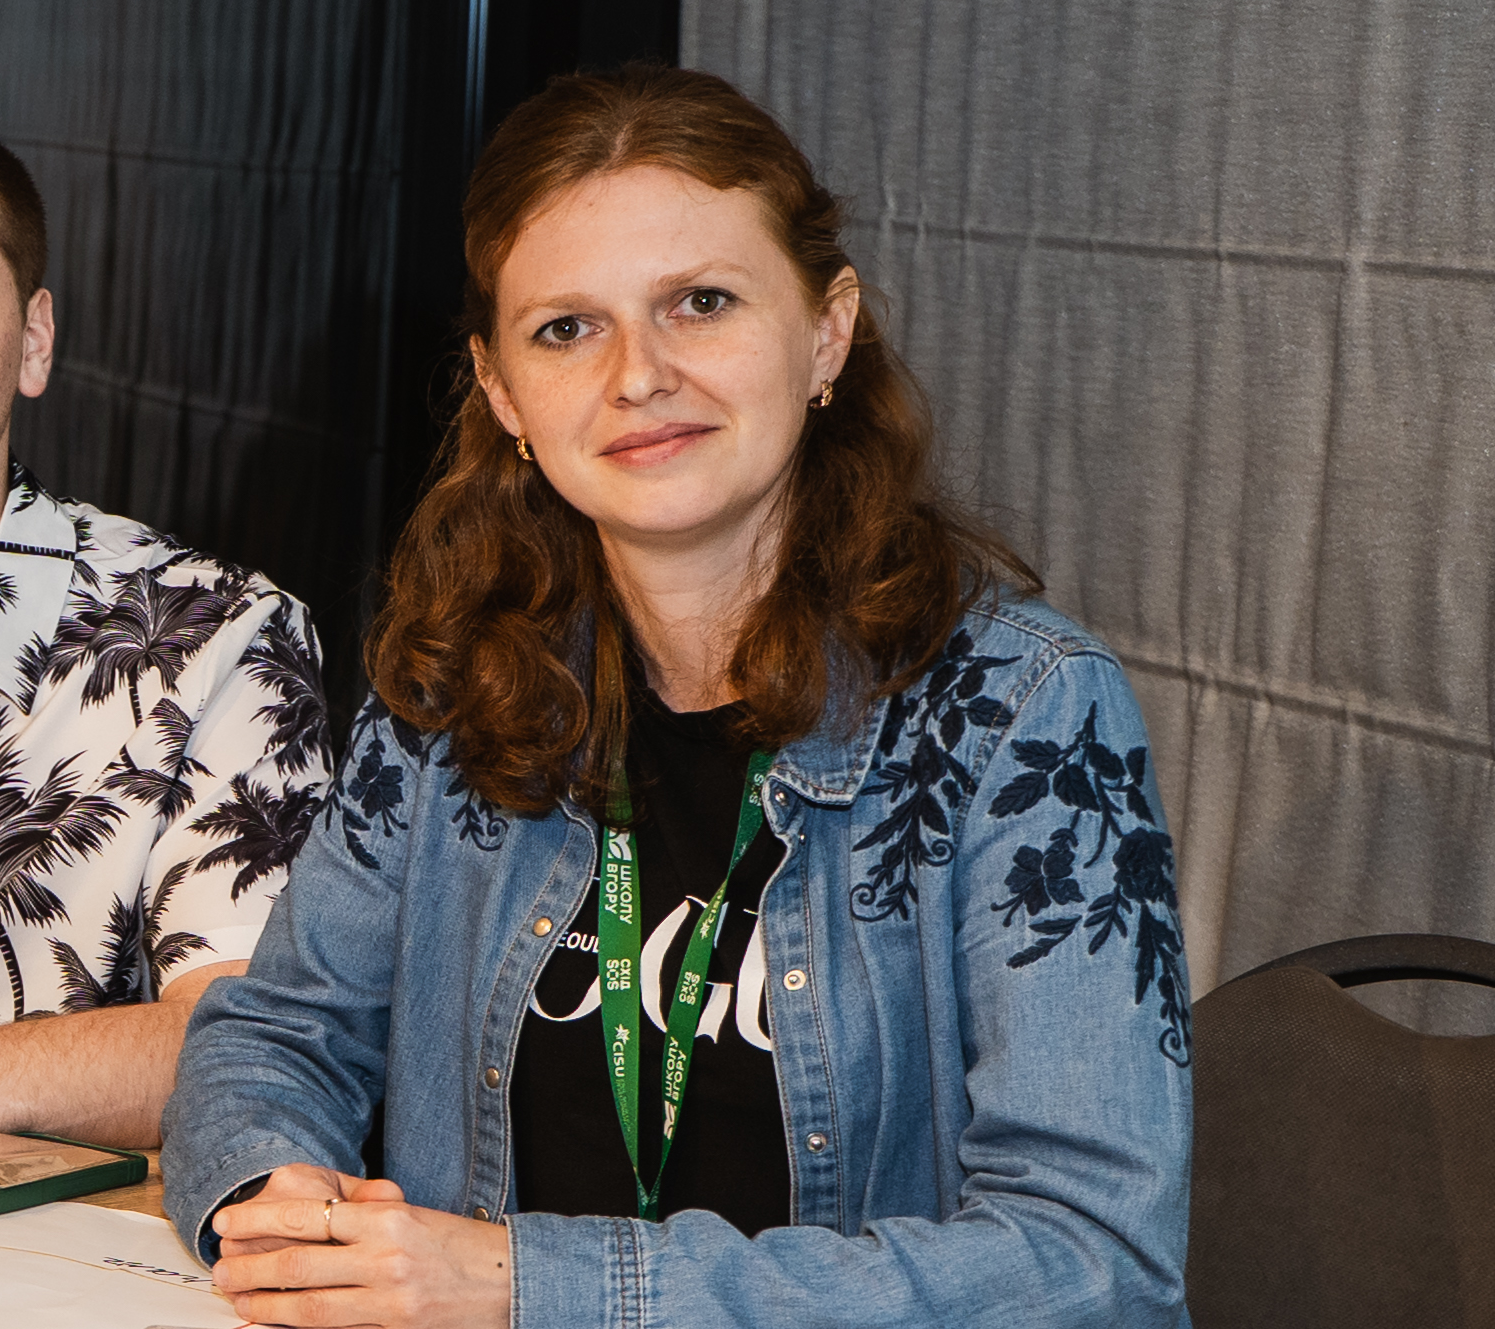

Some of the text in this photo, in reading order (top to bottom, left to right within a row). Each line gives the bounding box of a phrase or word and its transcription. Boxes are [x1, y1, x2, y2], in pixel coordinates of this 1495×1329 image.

[605, 863, 618, 915] ВГОРУ
[620, 865, 632, 924] ШКОЛУ
[606, 959, 619, 991] SOS
[620, 958, 631, 991] СХІД
[679, 971, 692, 1002] СХІД
[686, 973, 700, 1005] SOS
[612, 1041, 625, 1077] CISU
[665, 1036, 679, 1097] ШКОЛУ
[672, 1049, 686, 1101] ВГОРУ
